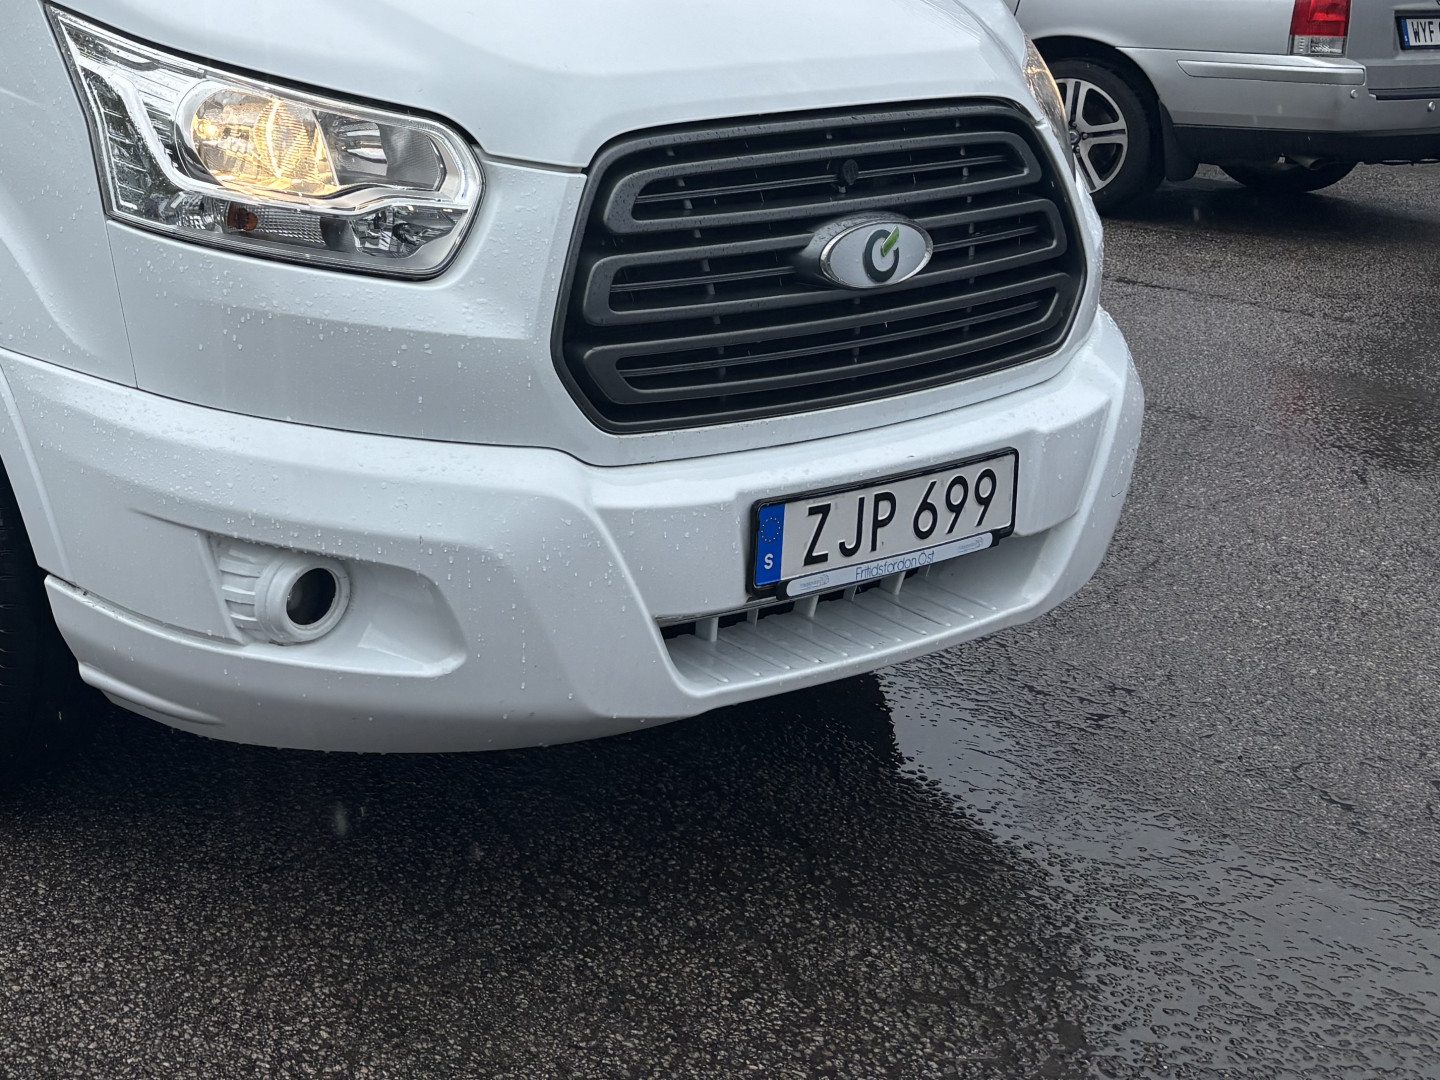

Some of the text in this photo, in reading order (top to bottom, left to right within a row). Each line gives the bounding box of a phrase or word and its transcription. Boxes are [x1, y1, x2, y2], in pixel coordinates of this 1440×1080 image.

[1411, 21, 1435, 43] WYF
[803, 468, 997, 567] ZJP 699
[763, 553, 774, 570] S
[855, 556, 917, 581] Fritidsfordon
